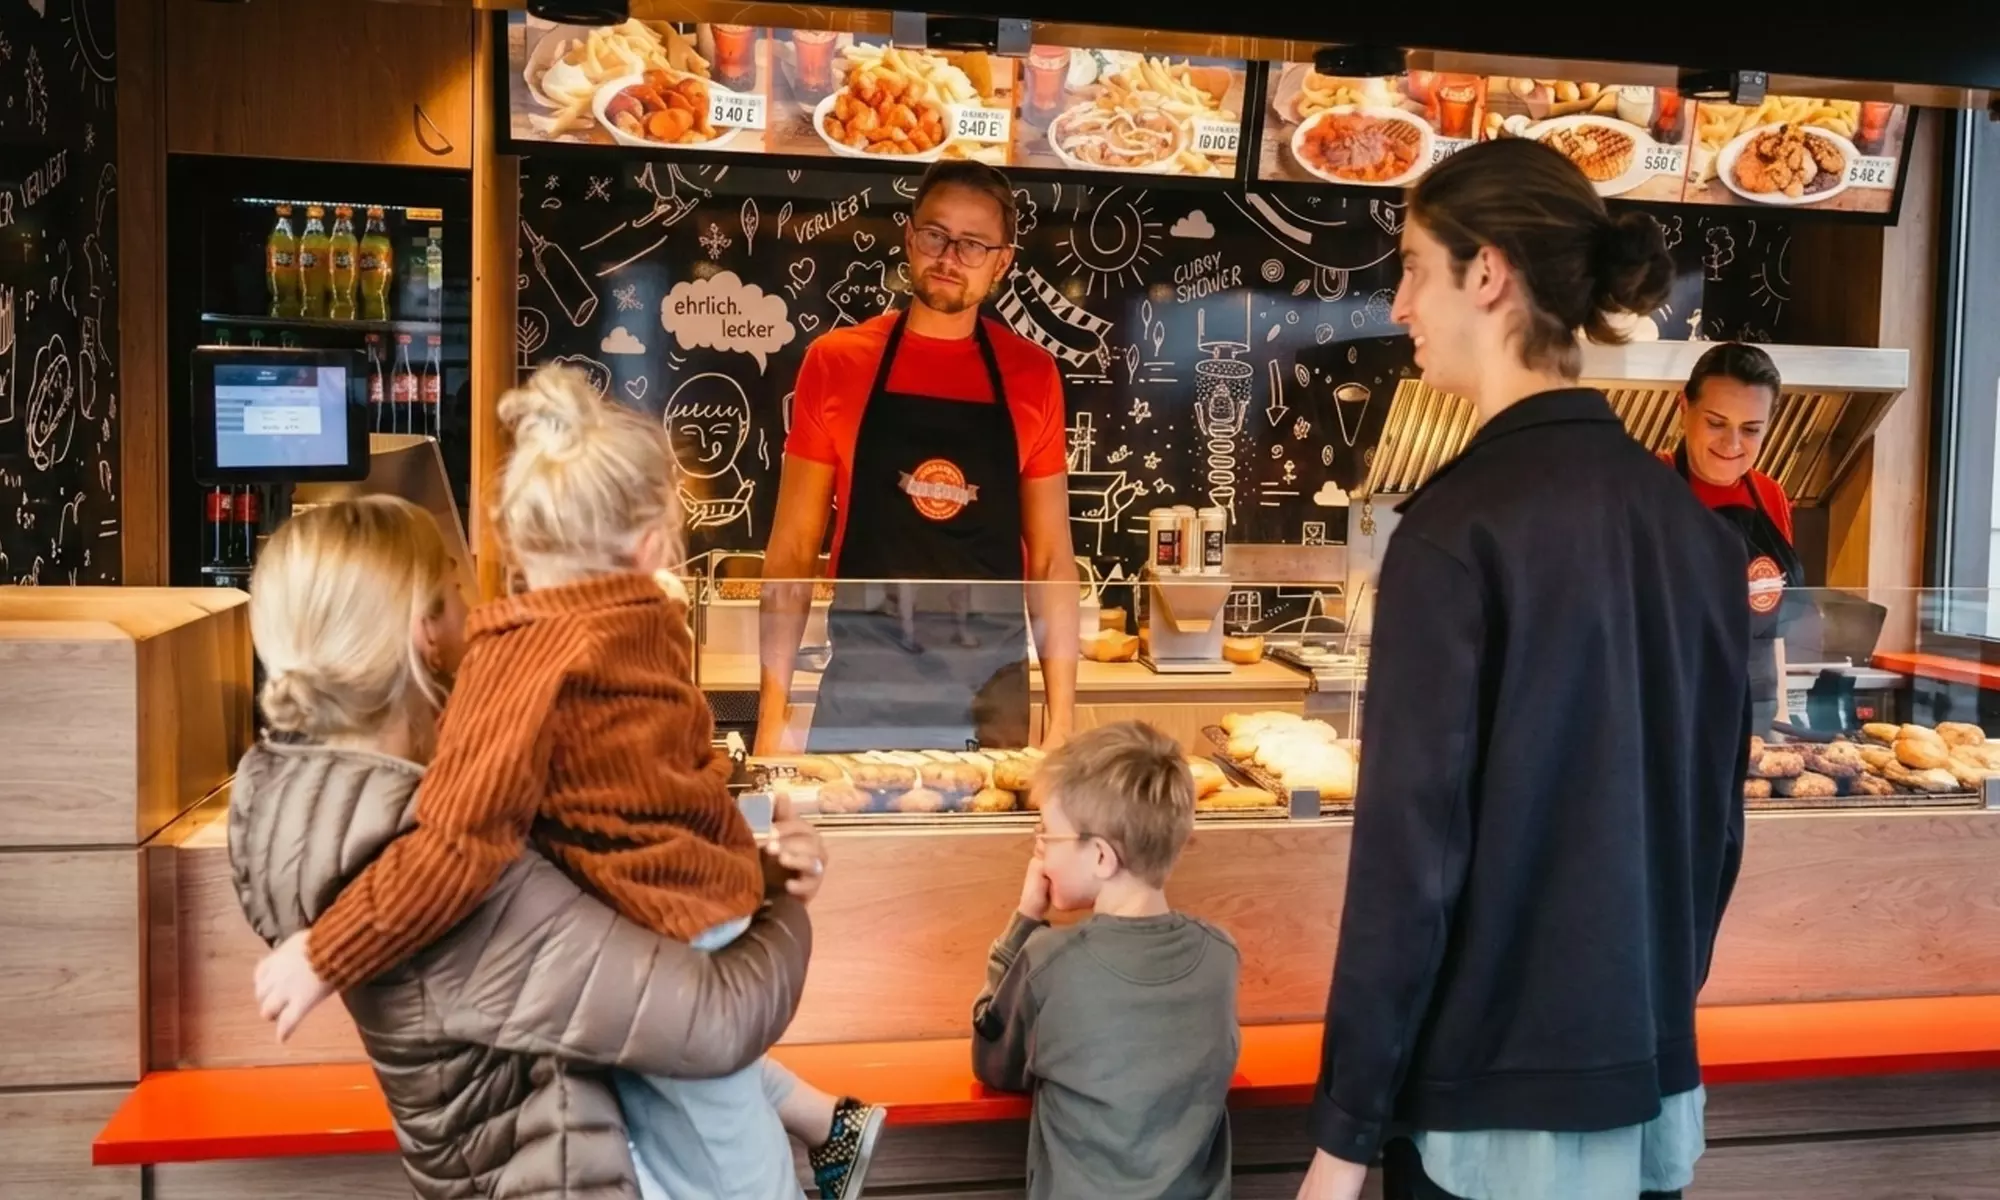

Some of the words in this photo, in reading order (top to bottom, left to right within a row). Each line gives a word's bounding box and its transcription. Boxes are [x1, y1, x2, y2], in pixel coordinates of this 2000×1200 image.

[793, 186, 872, 244] VERLIEBT
[674, 294, 743, 316] ehrlich.
[721, 318, 776, 338] lecker
